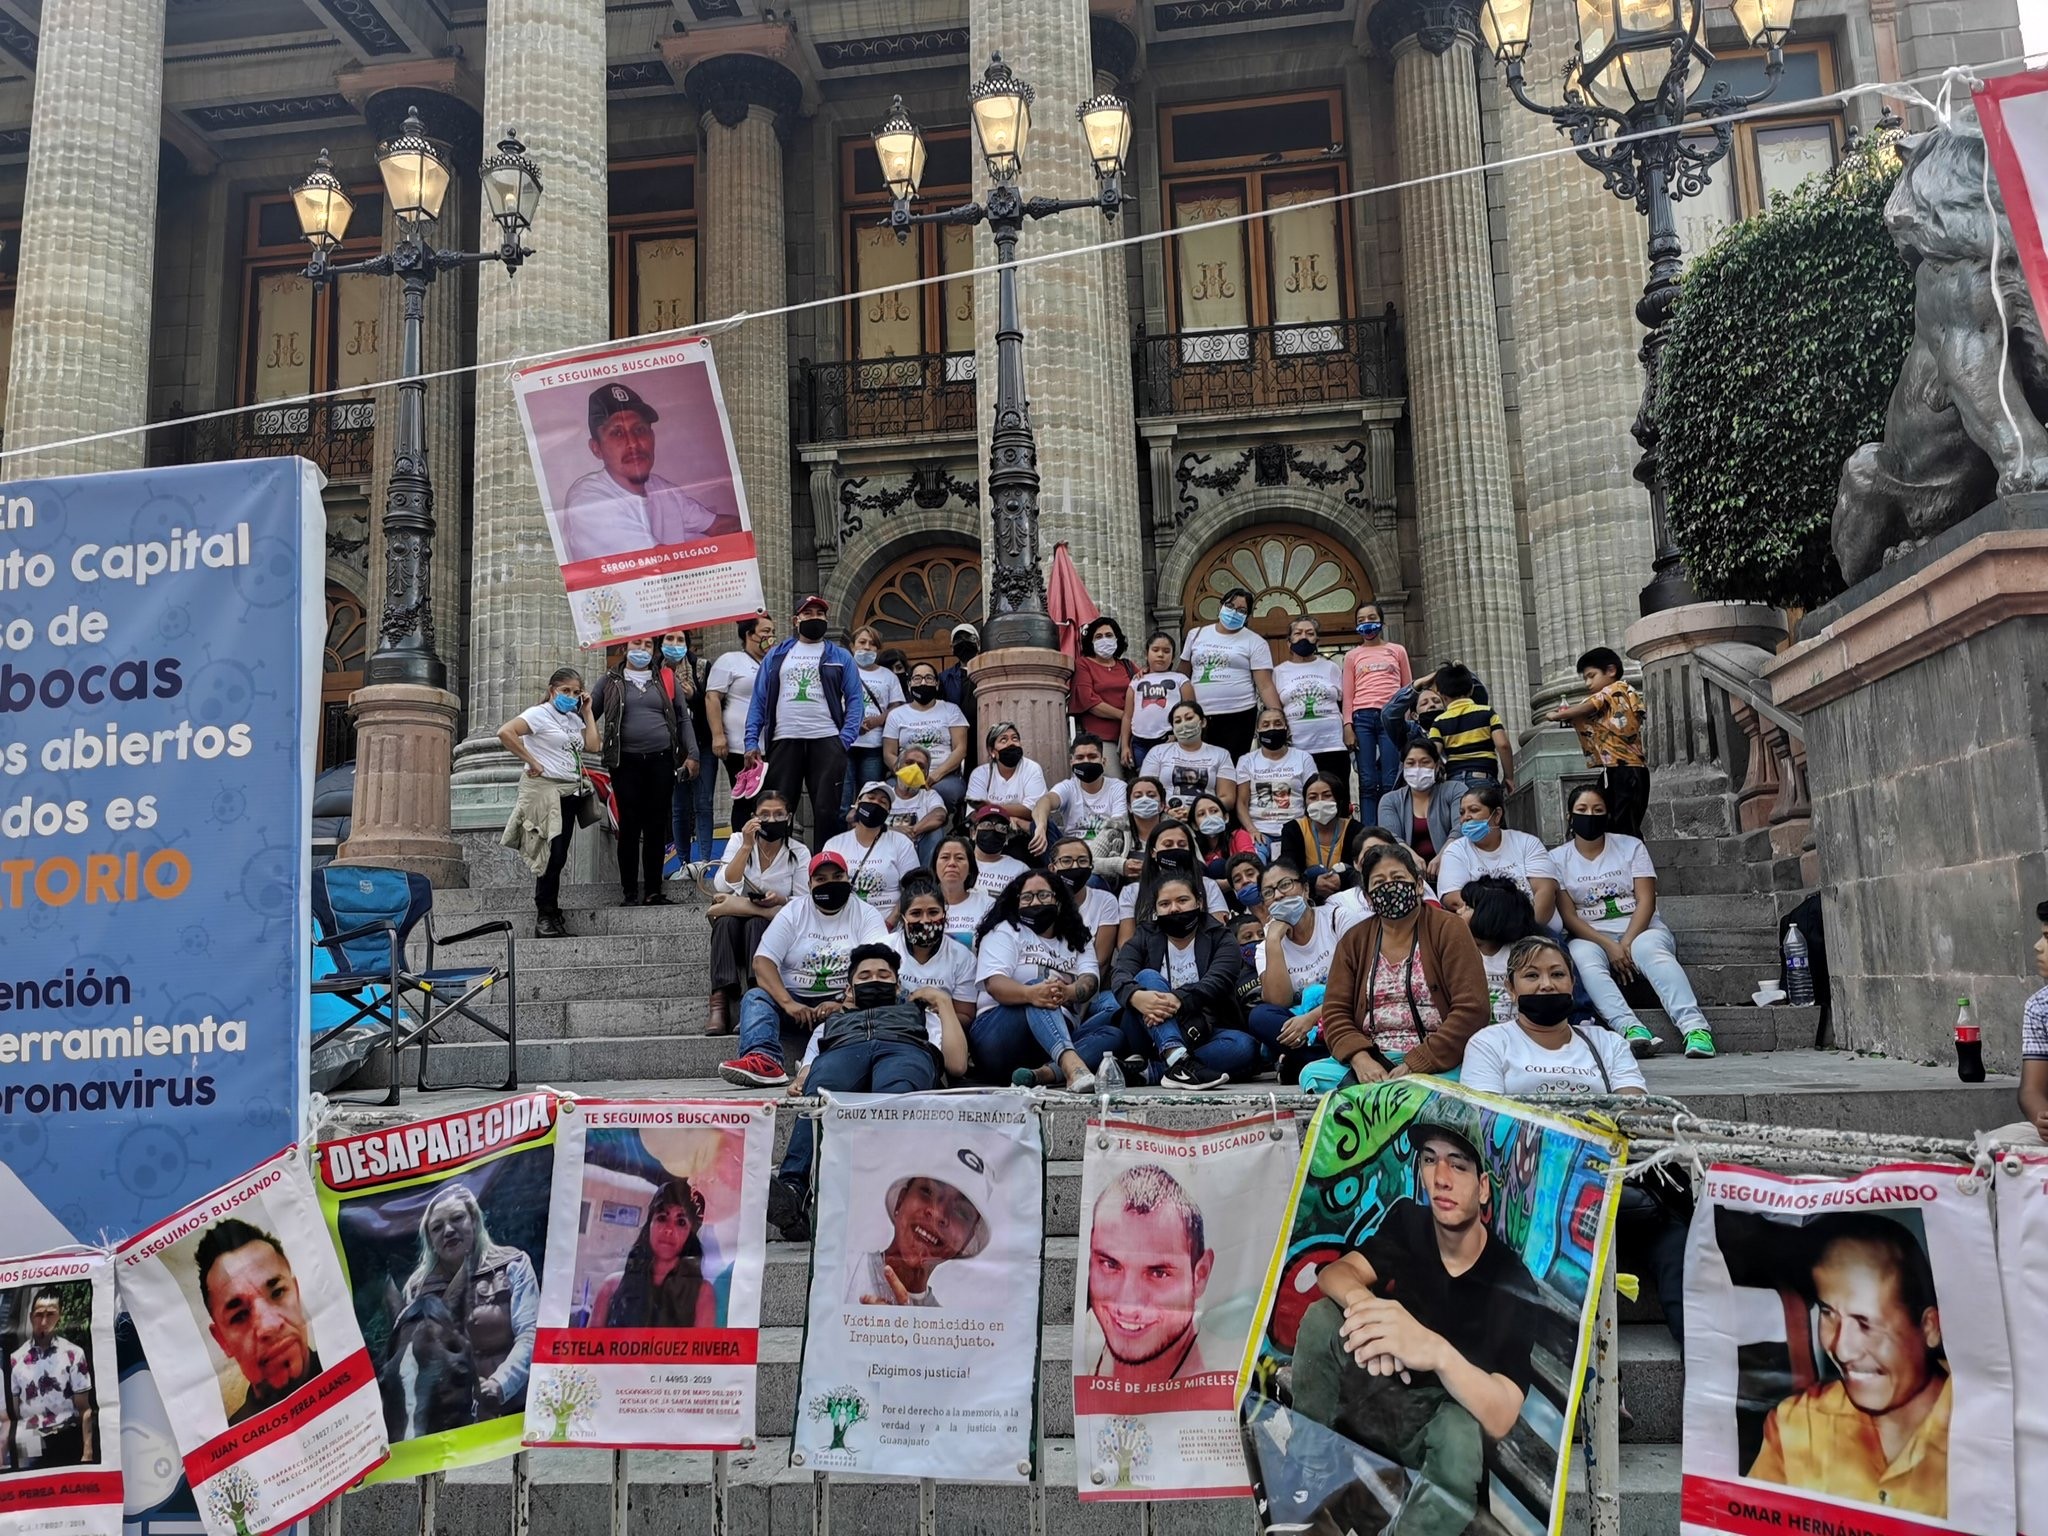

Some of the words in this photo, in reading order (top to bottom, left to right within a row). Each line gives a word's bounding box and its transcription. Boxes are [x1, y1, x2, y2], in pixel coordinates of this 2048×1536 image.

[540, 377, 554, 387] TE
[558, 364, 618, 384] SEGUIMOS
[622, 353, 685, 373] BUSCANDO
[0, 549, 55, 590] to
[601, 558, 636, 574] SERGIO
[638, 552, 671, 567] BANDA
[673, 545, 719, 560] DELGADO
[0, 618, 34, 650] o
[48, 605, 108, 646] de
[0, 742, 28, 776] s
[41, 720, 251, 772] abiertos
[105, 795, 158, 831] es
[1577, 870, 1622, 883] COLECTIVO
[808, 932, 849, 941] COLECTIVO
[0, 1068, 217, 1115] ronavirus
[584, 1112, 599, 1125] TE
[603, 1113, 675, 1125] SEGUIMOS
[678, 1113, 751, 1125] BUSCANDO
[836, 1108, 868, 1121] CRUZ
[870, 1108, 899, 1121] YAIR
[902, 1109, 955, 1122] PACHECO
[958, 1109, 1027, 1125] HERNÁNDEZ
[328, 1094, 551, 1185] DESAPARECIDA
[1118, 1137, 1132, 1151] TE
[1136, 1140, 1197, 1158] SEGUIMOS
[1202, 1130, 1267, 1155] BUSCANDO
[1706, 1182, 1720, 1198] TE
[1720, 1184, 1818, 1210] SEGUIMOS
[1821, 1184, 1939, 1207] BUSCANDO
[125, 1252, 142, 1267] TE
[139, 1212, 210, 1261] SEGUIMOS
[210, 1170, 282, 1219] BUSCANDO
[22, 1262, 90, 1280] BUSCANDO
[843, 1314, 891, 1330] Víctima
[894, 1317, 910, 1330] de
[912, 1316, 985, 1332] homicidio
[988, 1321, 1005, 1332] en
[551, 1340, 605, 1356] ESTELA
[609, 1336, 688, 1357] RODRÍGUEZ
[691, 1340, 740, 1356] RIVERA
[848, 1330, 910, 1347] Irapuato,
[912, 1332, 996, 1349] Guanajuato.
[867, 1364, 922, 1380] ¡Exigimos
[922, 1365, 971, 1382] justicia!
[1089, 1376, 1122, 1392] JOSÉ
[1124, 1380, 1142, 1394] DE
[1144, 1377, 1182, 1394] JESÚS
[1184, 1375, 1236, 1391] MIRELES
[209, 1438, 239, 1464] JUAN
[242, 1412, 289, 1445] CARLOS
[289, 1394, 317, 1422] PEREA
[316, 1370, 352, 1405] ALANIS
[882, 1404, 896, 1414] Por
[898, 1406, 906, 1415] el
[908, 1406, 944, 1416] derecho
[953, 1408, 960, 1417] la
[1011, 1408, 1019, 1418] la
[881, 1421, 910, 1430] verdad
[920, 1424, 925, 1433] y
[950, 1422, 958, 1432] la
[879, 1435, 930, 1447] Guanajuato
[1728, 1501, 1782, 1526] OMAR
